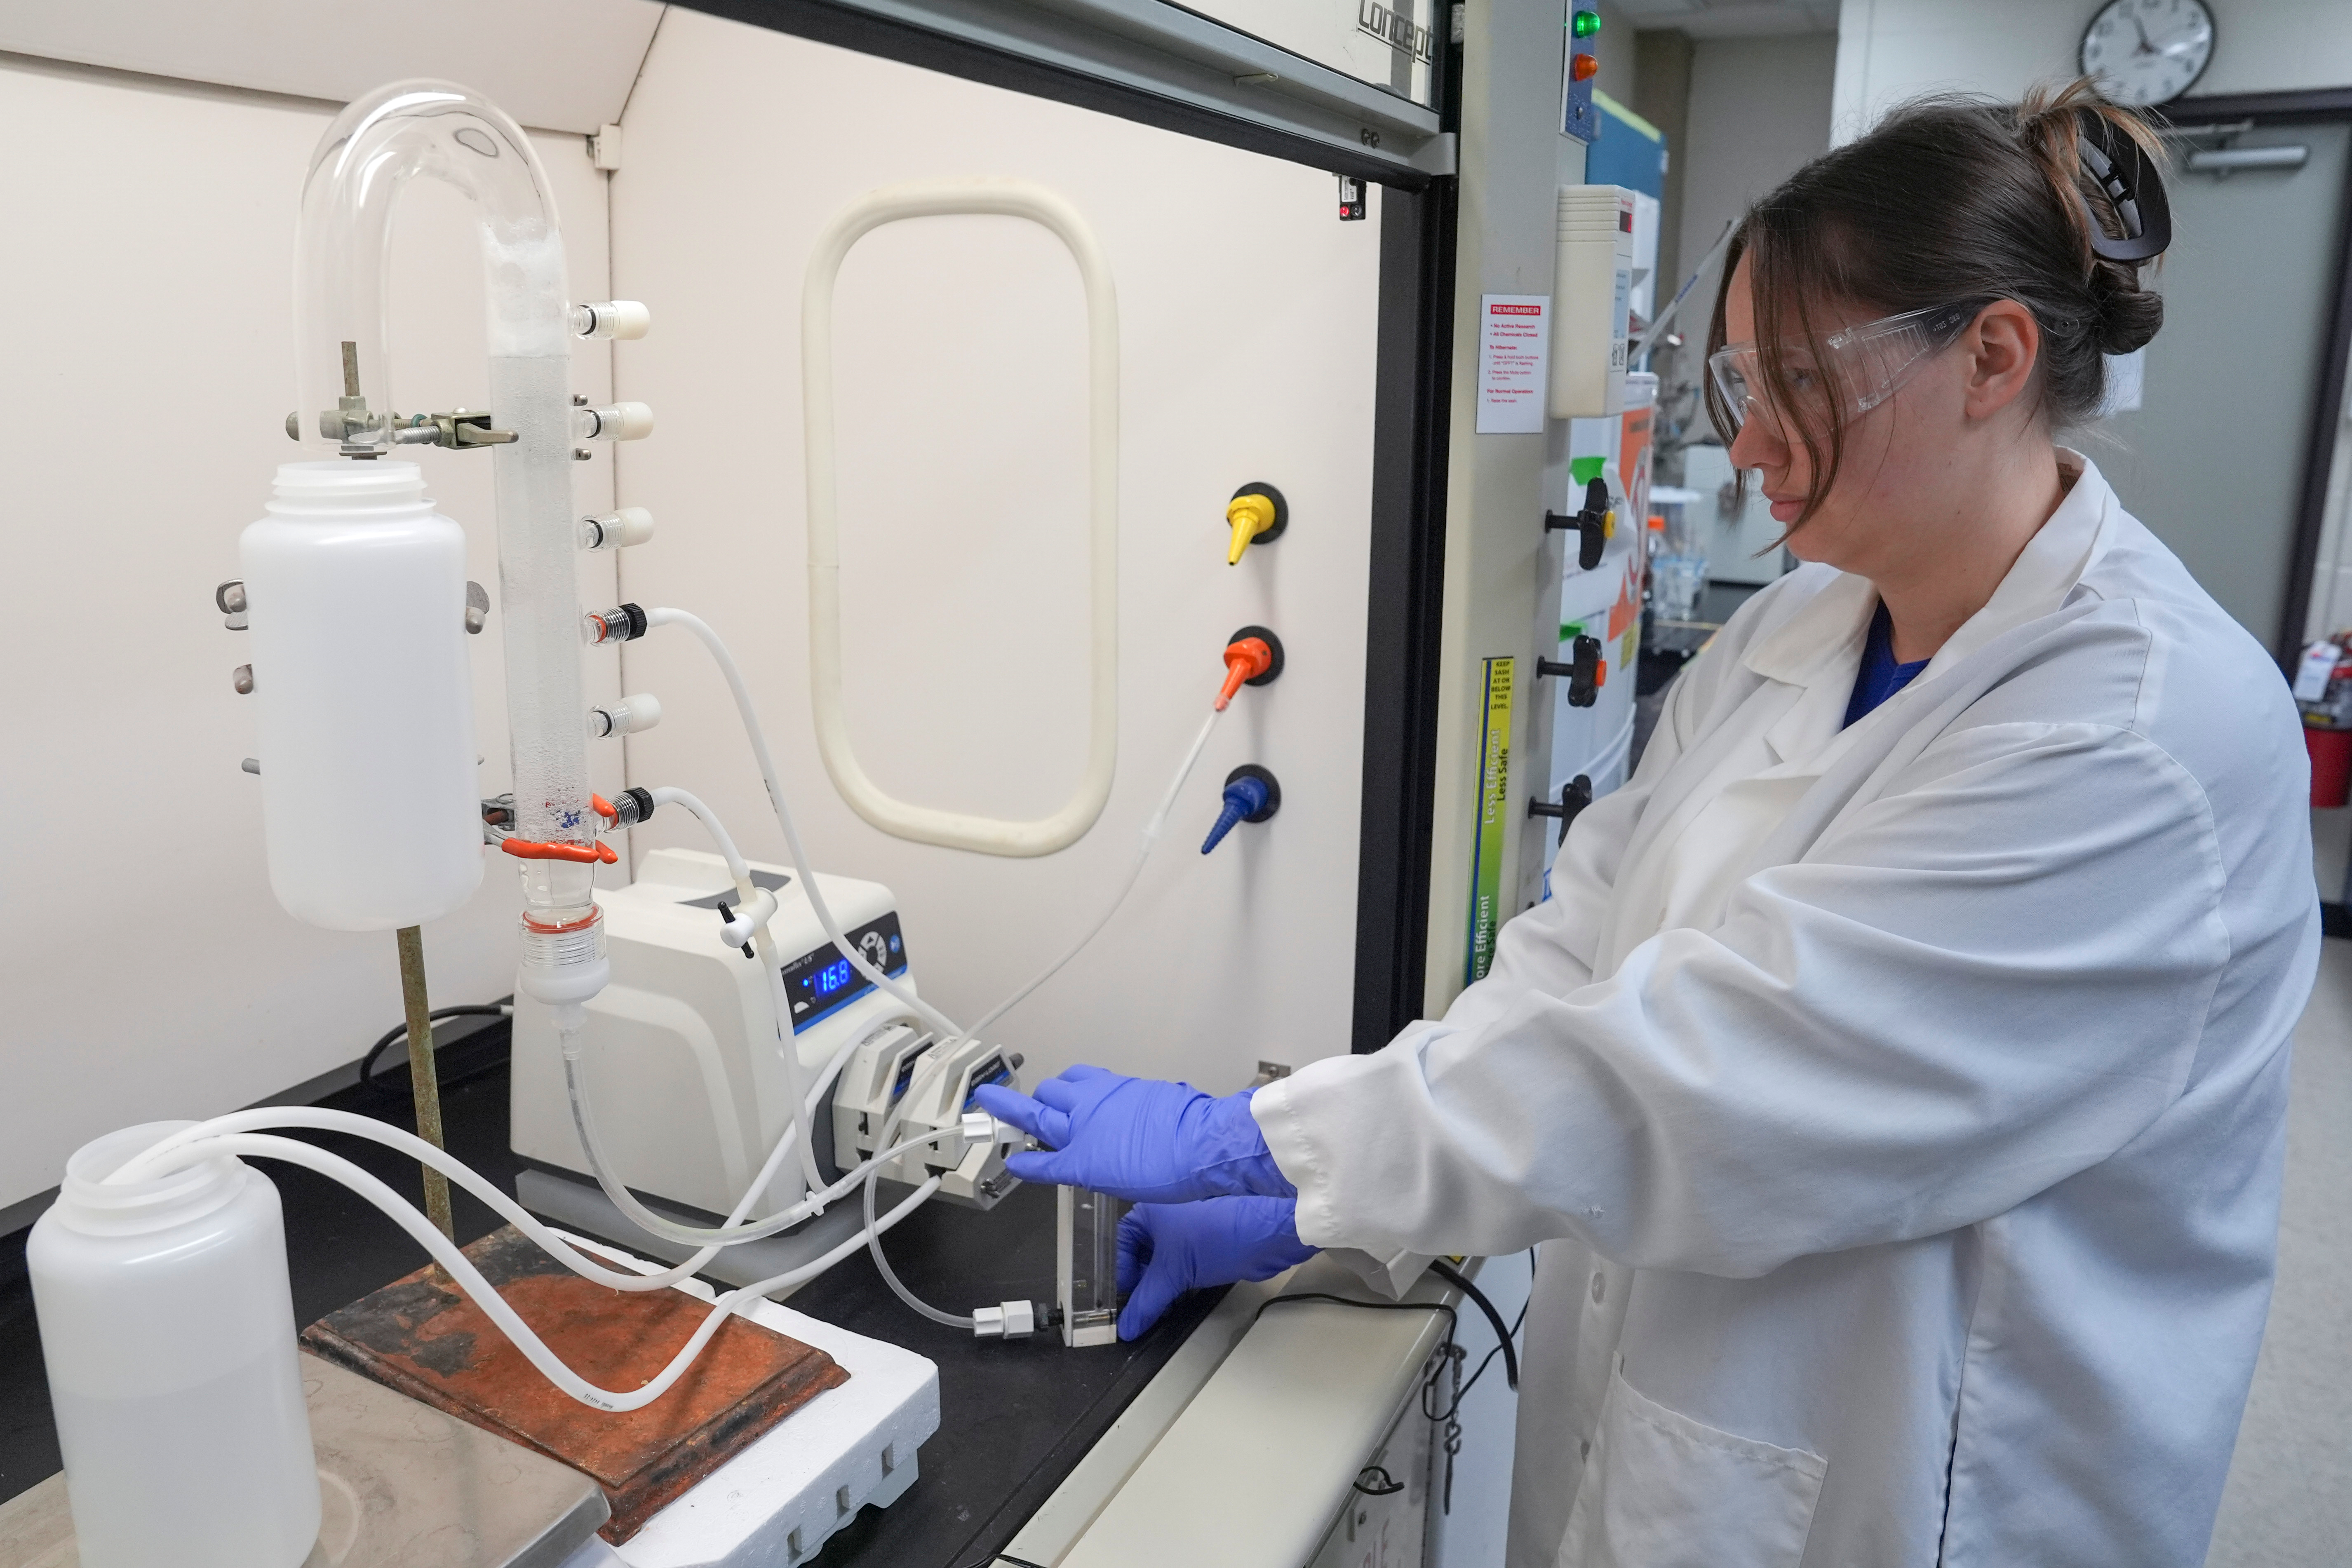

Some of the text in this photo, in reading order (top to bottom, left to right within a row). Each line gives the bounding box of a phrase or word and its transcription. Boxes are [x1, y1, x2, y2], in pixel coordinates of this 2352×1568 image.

[1484, 728, 1501, 824] Less Efficient
[1497, 748, 1508, 801] Less Safe
[1475, 894, 1490, 979] ore Efficient
